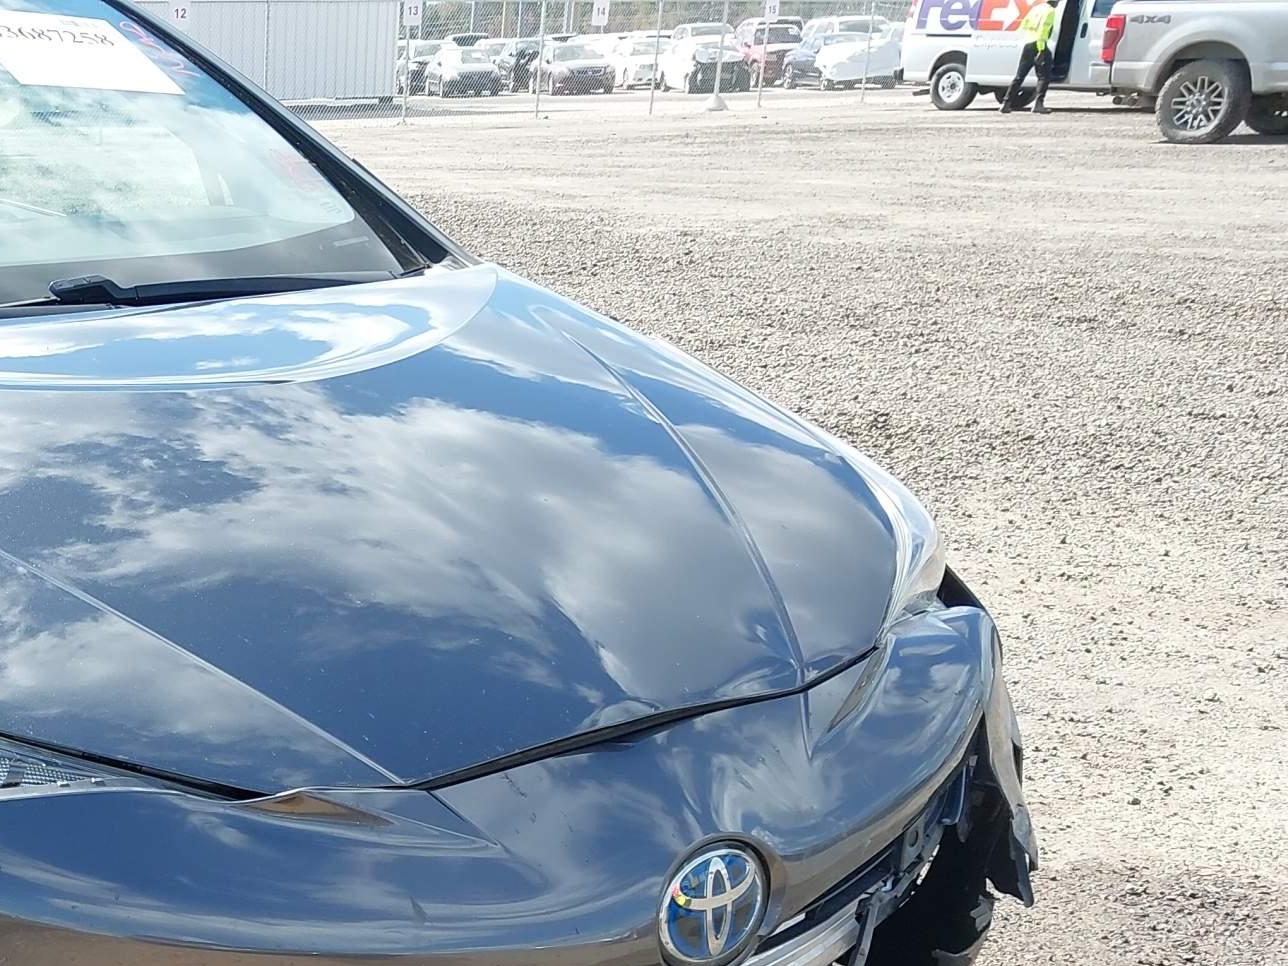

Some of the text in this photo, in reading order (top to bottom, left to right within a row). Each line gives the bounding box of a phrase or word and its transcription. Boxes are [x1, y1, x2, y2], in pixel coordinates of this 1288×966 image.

[174, 8, 187, 19] 12
[407, 6, 419, 17] 13
[596, 7, 606, 16] 14
[768, 6, 777, 14] 15
[915, 0, 1045, 31] FedEx
